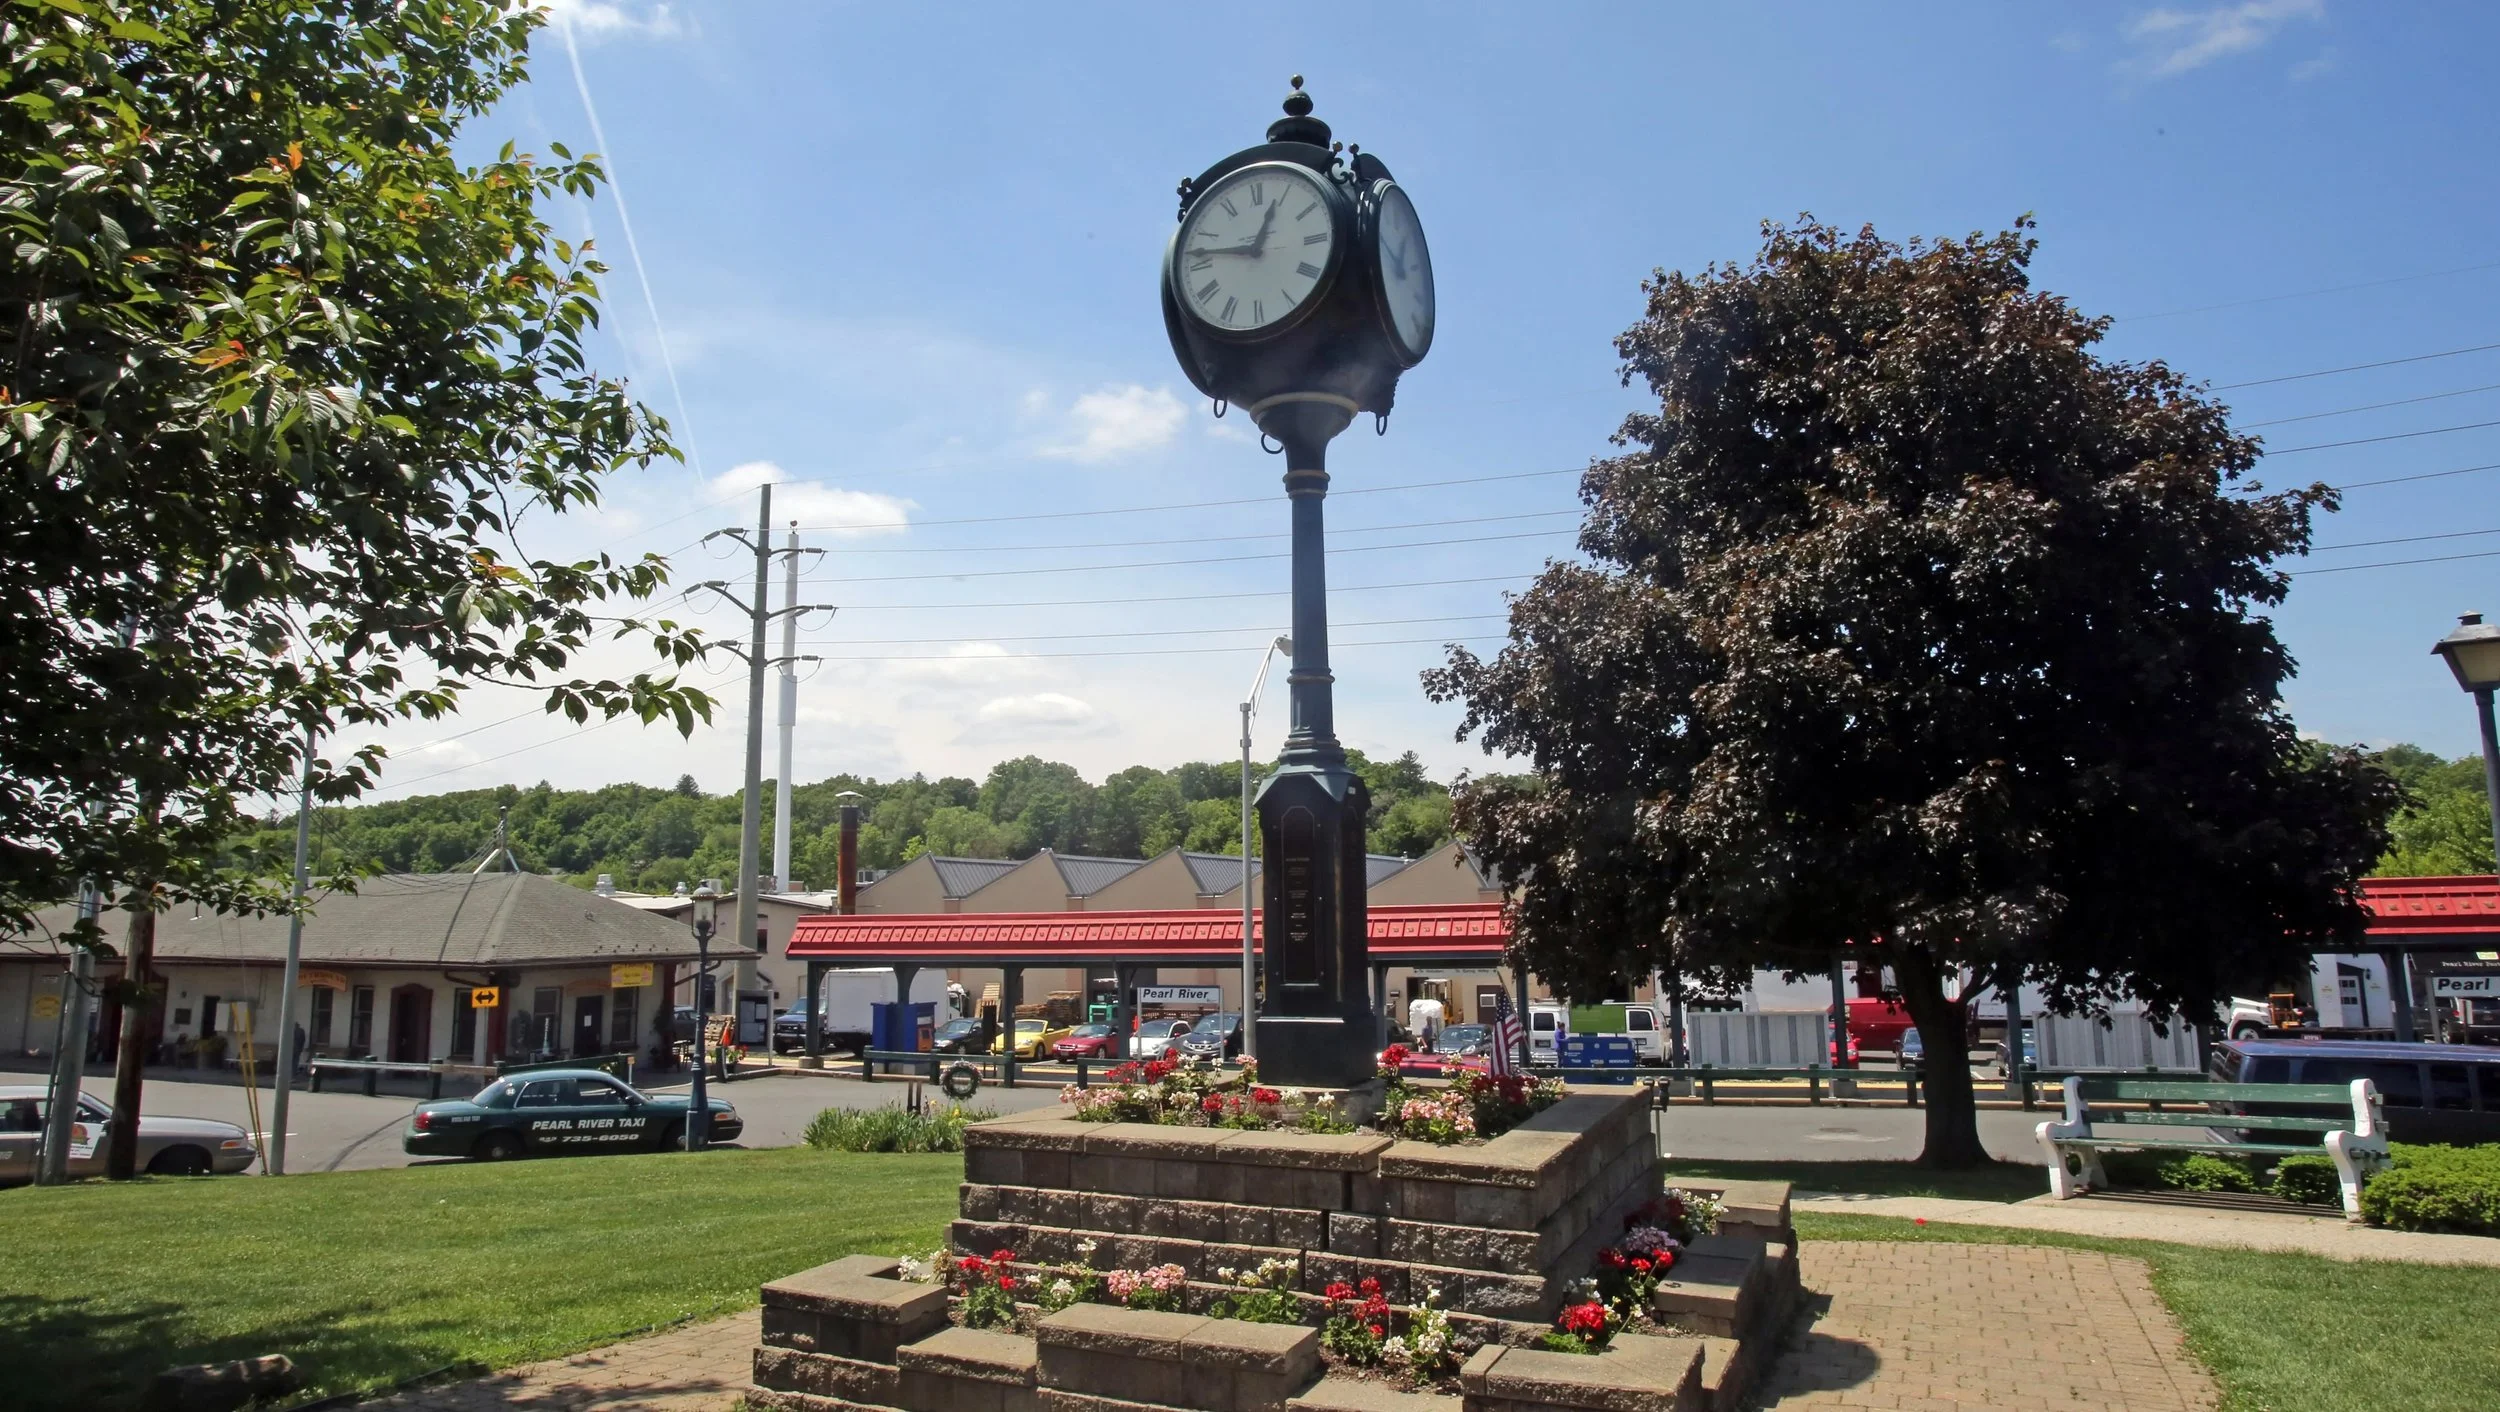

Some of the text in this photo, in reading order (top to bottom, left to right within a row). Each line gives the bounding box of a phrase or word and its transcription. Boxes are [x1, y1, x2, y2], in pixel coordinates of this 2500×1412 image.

[2438, 978, 2489, 990] Pearl
[1143, 988, 1209, 998] Pearl River
[532, 1118, 646, 1130] PEARL RIVER TAXI
[561, 1133, 640, 1143] 735-6050
